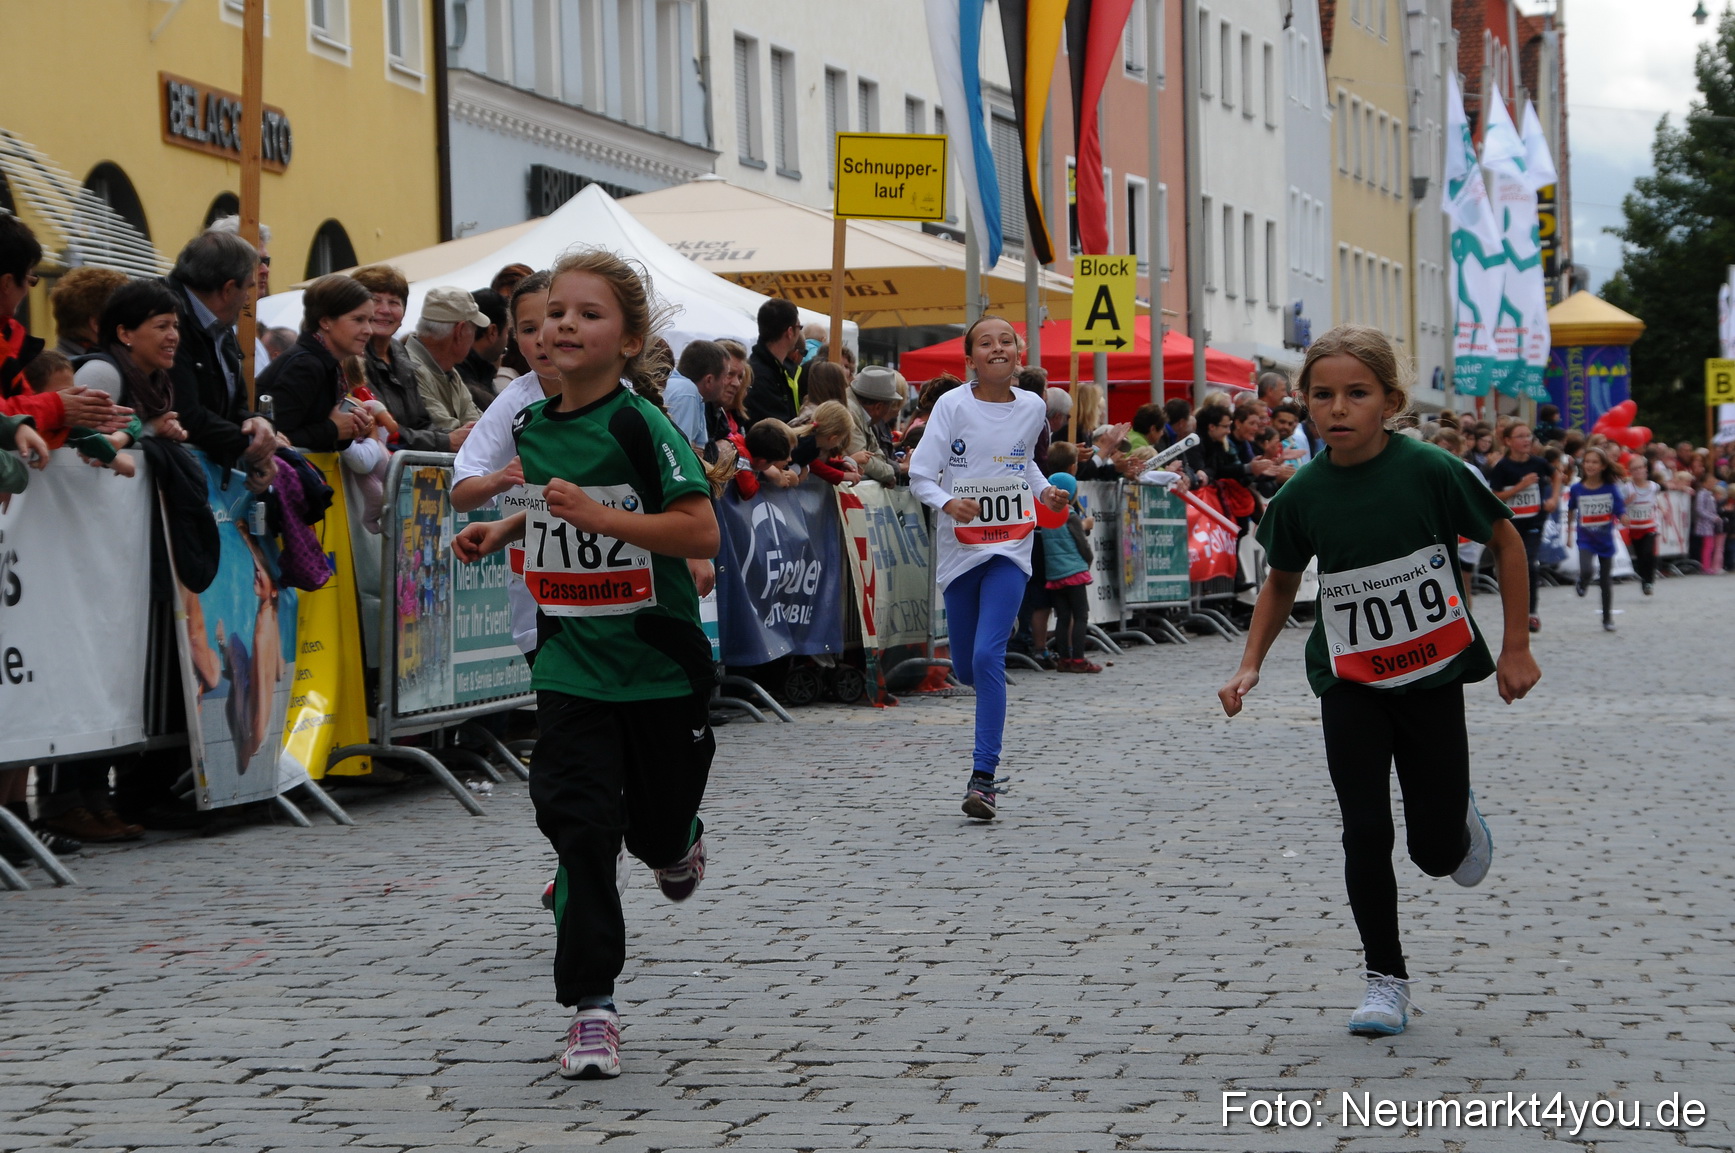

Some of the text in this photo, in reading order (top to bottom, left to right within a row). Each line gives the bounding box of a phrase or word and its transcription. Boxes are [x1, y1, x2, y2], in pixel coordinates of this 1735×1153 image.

[843, 157, 938, 180] Schnupper-
[874, 181, 906, 199] lauf
[1080, 259, 1129, 276] Block
[1084, 284, 1121, 331] A
[1715, 372, 1733, 394] B
[661, 442, 677, 467] erima
[953, 483, 1020, 494] PARTL Neumarkt
[961, 493, 1023, 522] 001
[533, 521, 632, 570] 7182
[981, 529, 1010, 542] Julia
[637, 557, 647, 566] W
[539, 579, 633, 600] Cassandra
[1322, 563, 1428, 600] PARTL Neumarkt
[1333, 578, 1447, 646] 7019
[1371, 642, 1438, 675] Svenja
